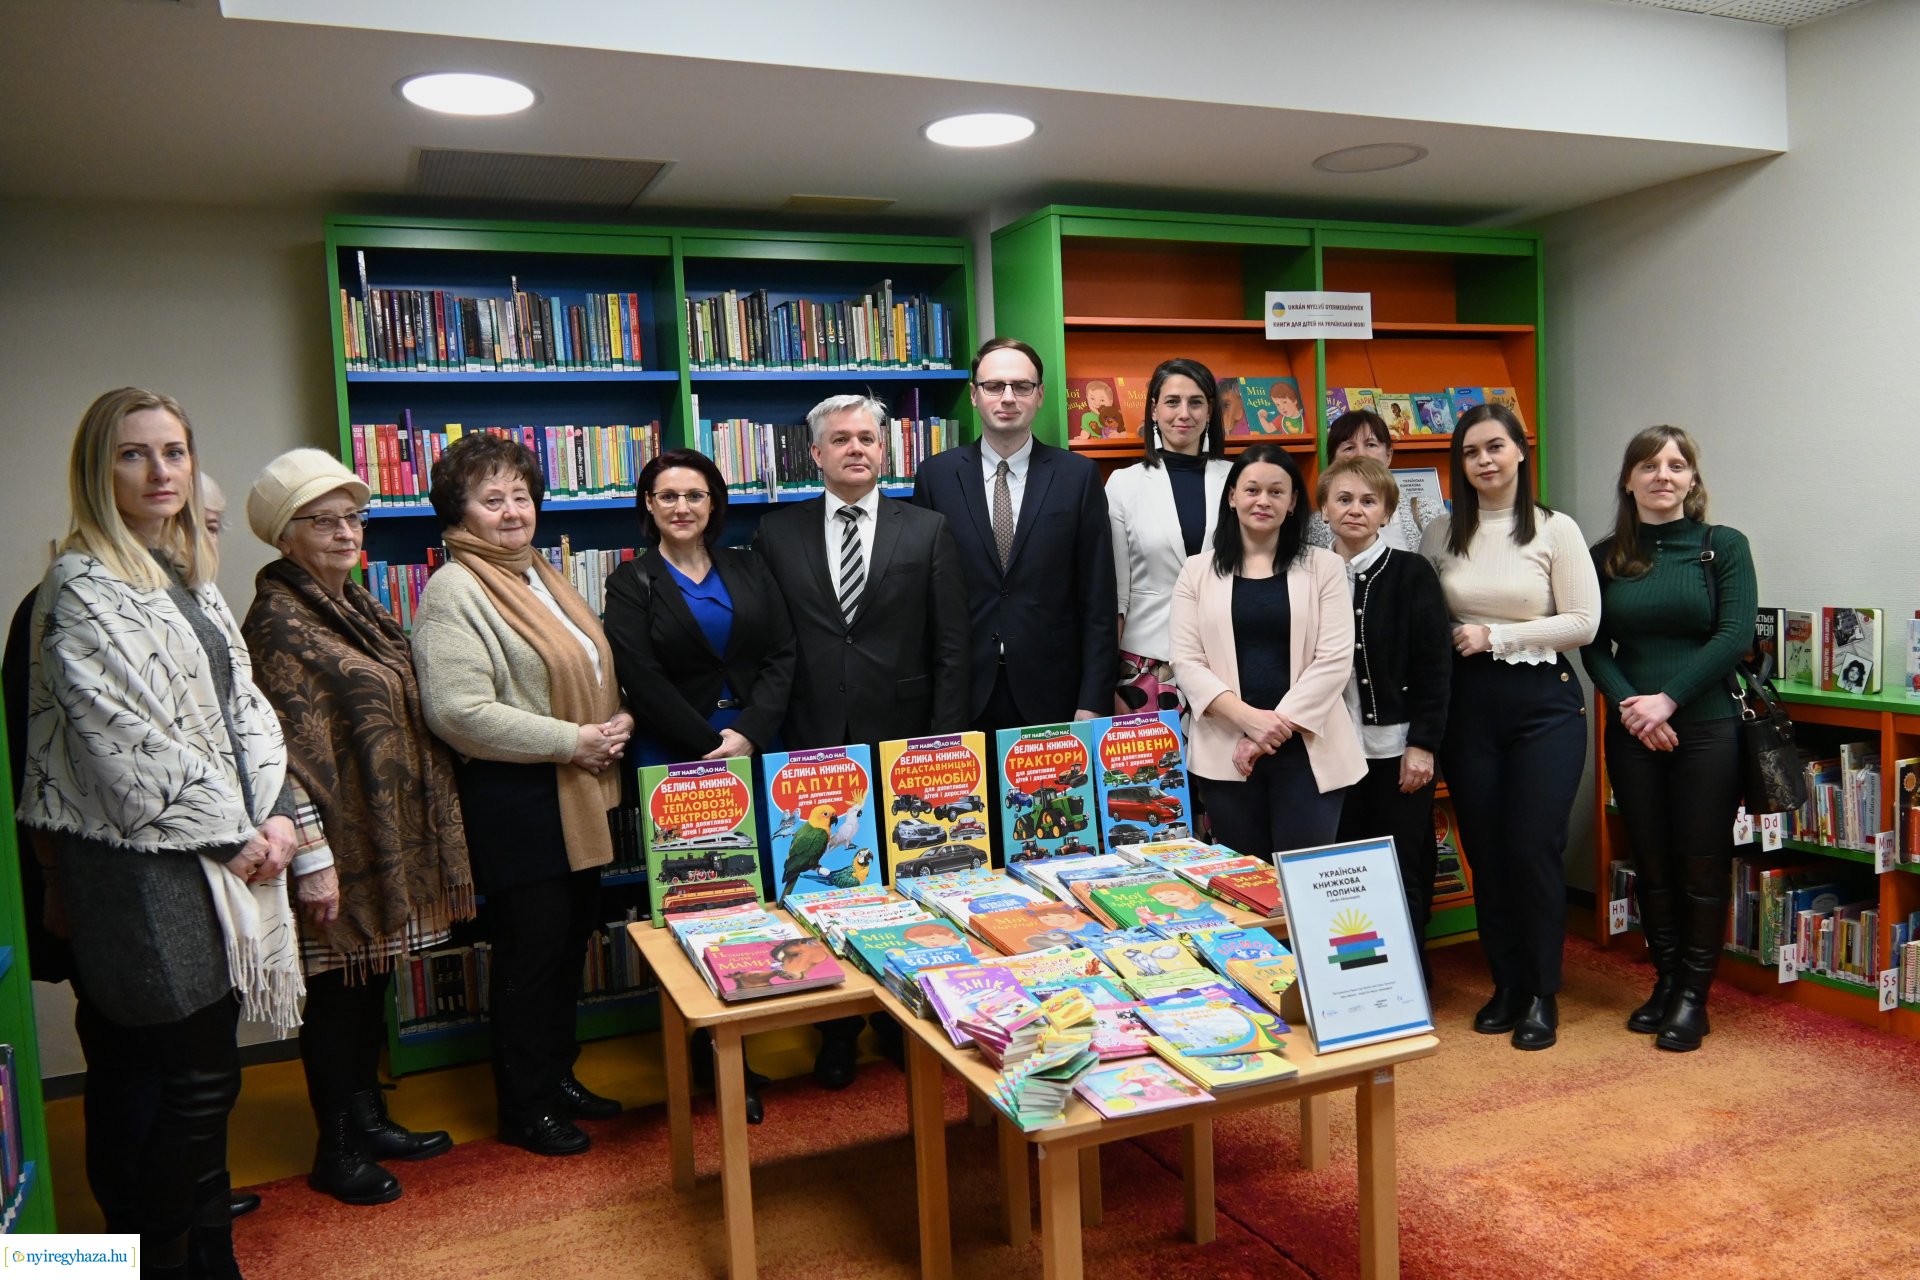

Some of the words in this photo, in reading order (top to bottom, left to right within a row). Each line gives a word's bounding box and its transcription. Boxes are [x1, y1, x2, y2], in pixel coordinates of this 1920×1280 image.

[1288, 302, 1306, 310] UKRÁN
[1106, 730, 1136, 741] ВЕЛИКА
[1138, 726, 1169, 737] КНИЖКА
[1014, 743, 1044, 755] ВЕЛИКА
[1046, 739, 1079, 751] КНИЖКА
[1105, 737, 1173, 756] МІНІВЕНИ
[900, 754, 933, 766] ВЕЛИКА
[936, 750, 971, 762] КНИЖКА
[1009, 750, 1083, 770] ТРАКТОРИ
[782, 767, 817, 779] ВЕЛИКА
[820, 763, 857, 775] КНИЖКА
[894, 758, 976, 776] ПРЕДСТАВНИЦЬКІ
[661, 780, 696, 794] ВЕЛИКА
[699, 776, 737, 790] КНИЖКА
[781, 773, 860, 795] ПАПУГИ
[898, 767, 977, 790] АВТОМОБІЛІ
[665, 787, 734, 803] ПАРОВОЗИ,
[662, 798, 738, 814] ТЕПЛОВОЗИ,
[659, 807, 743, 826] ЕЛЕКТРОВОЗИ
[1765, 817, 1770, 830] D
[1772, 816, 1778, 828] d
[1319, 866, 1367, 879] УКРАЇНСЬКА
[1313, 876, 1360, 890] КНИЖКОВА
[1326, 885, 1366, 898] ПОЛИЧКА
[1612, 905, 1618, 914] H
[1620, 902, 1624, 913] h
[1884, 976, 1889, 988] S
[1891, 976, 1896, 986] s
